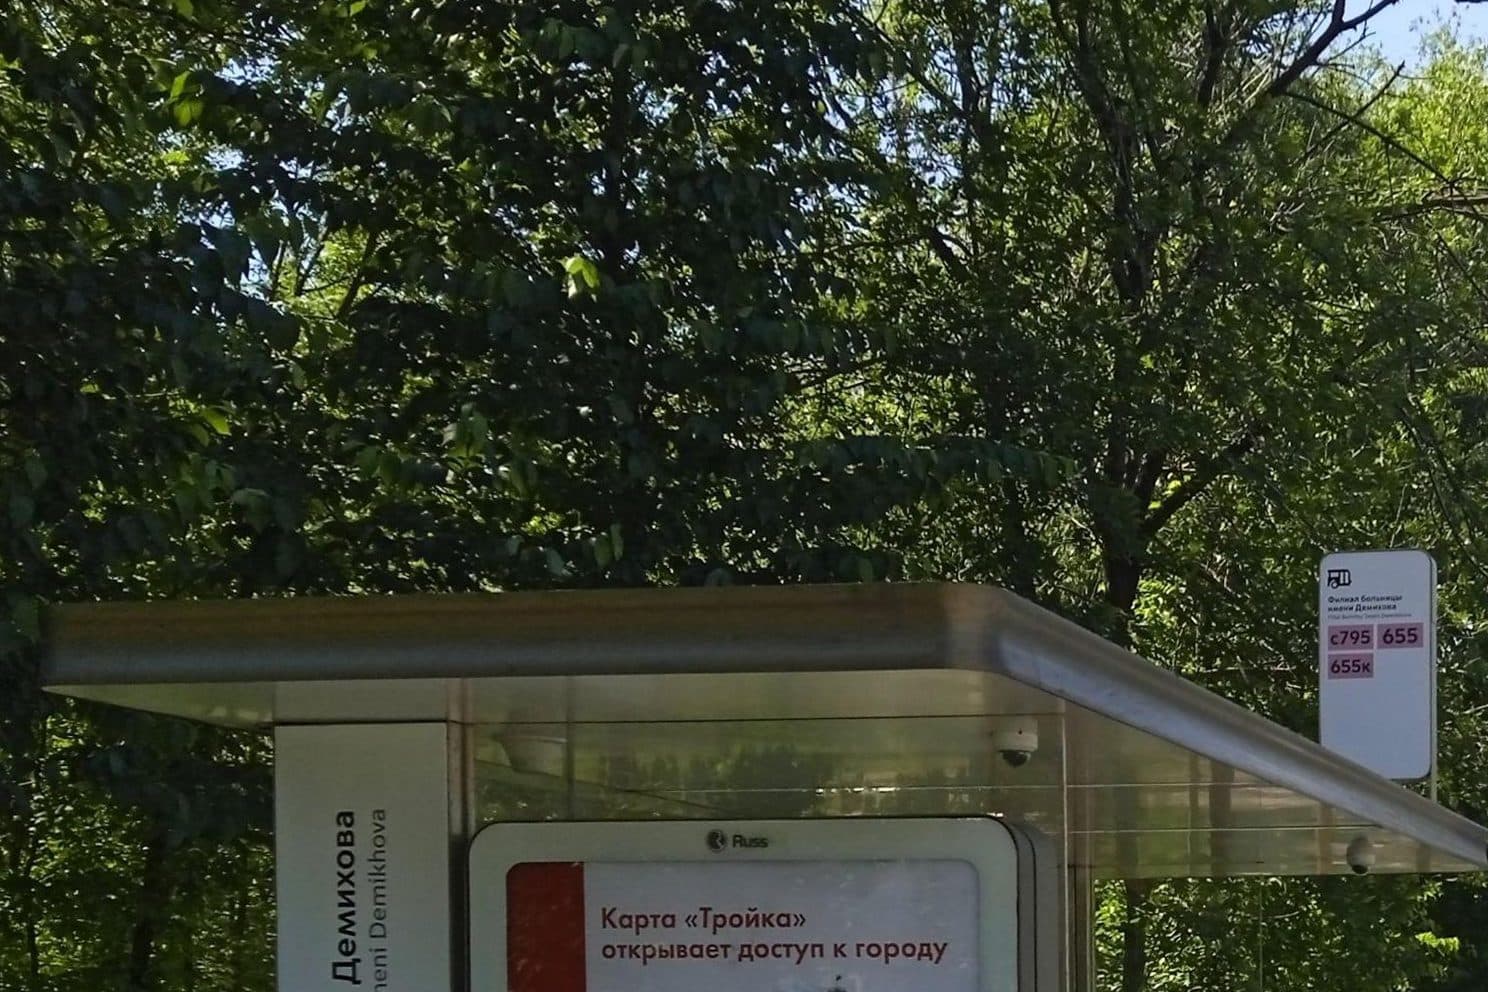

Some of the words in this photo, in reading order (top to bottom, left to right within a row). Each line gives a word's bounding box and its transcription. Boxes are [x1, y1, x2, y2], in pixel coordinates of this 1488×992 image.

[1328, 595, 1359, 604] Филиал
[1361, 594, 1403, 603] больницы
[1330, 629, 1371, 645] с795
[1382, 627, 1418, 645] 655
[1331, 658, 1371, 674] 655к
[732, 834, 769, 849] Russ
[368, 808, 387, 939] Demikhova
[332, 810, 362, 985] Демихова
[601, 907, 676, 933] Карта
[685, 906, 806, 933] «Тройка»
[602, 941, 732, 965] открывает
[738, 941, 825, 965] доступ
[834, 941, 847, 959] к
[855, 941, 948, 965] городу
